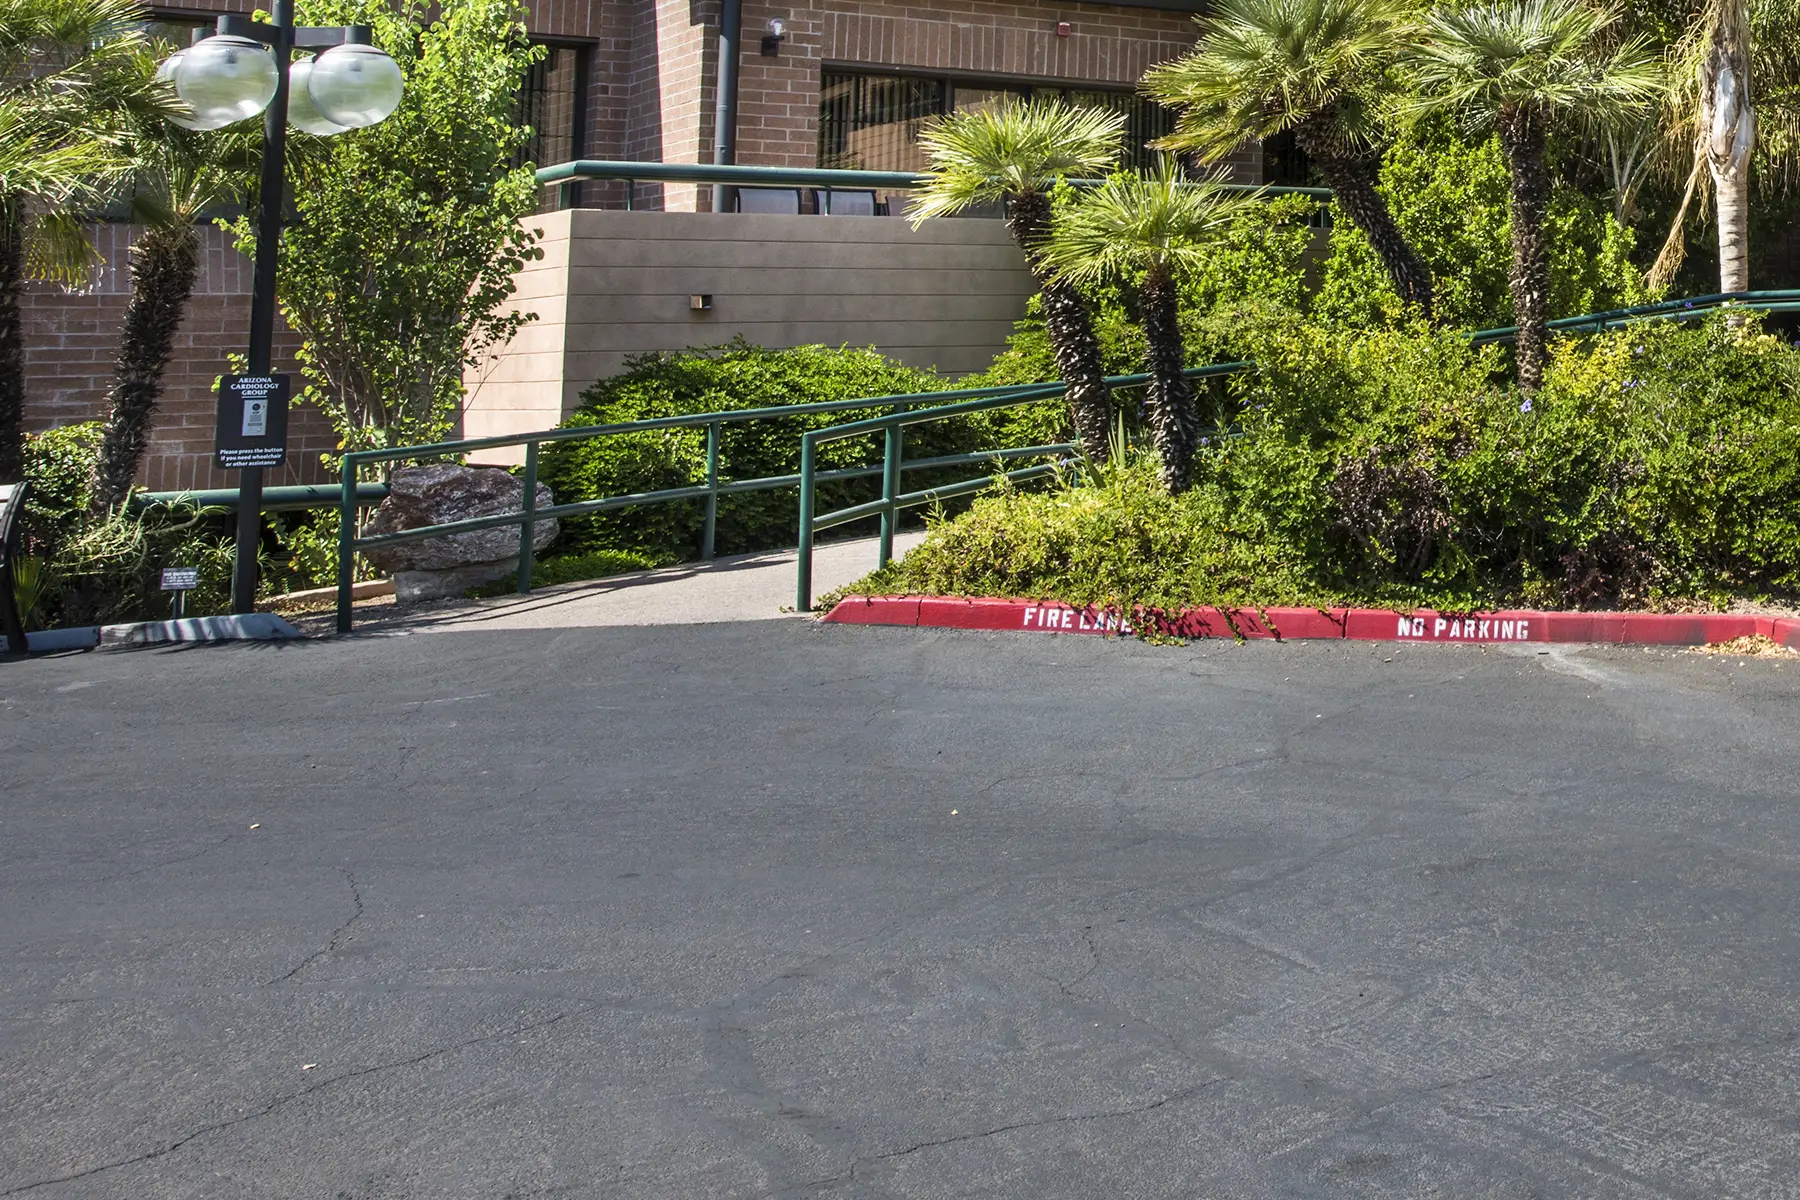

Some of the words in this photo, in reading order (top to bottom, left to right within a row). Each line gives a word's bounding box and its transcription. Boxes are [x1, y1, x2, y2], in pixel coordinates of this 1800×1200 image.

[1023, 607, 1075, 629] FIRE
[1397, 617, 1424, 637] NO
[1434, 618, 1529, 639] PARKING
